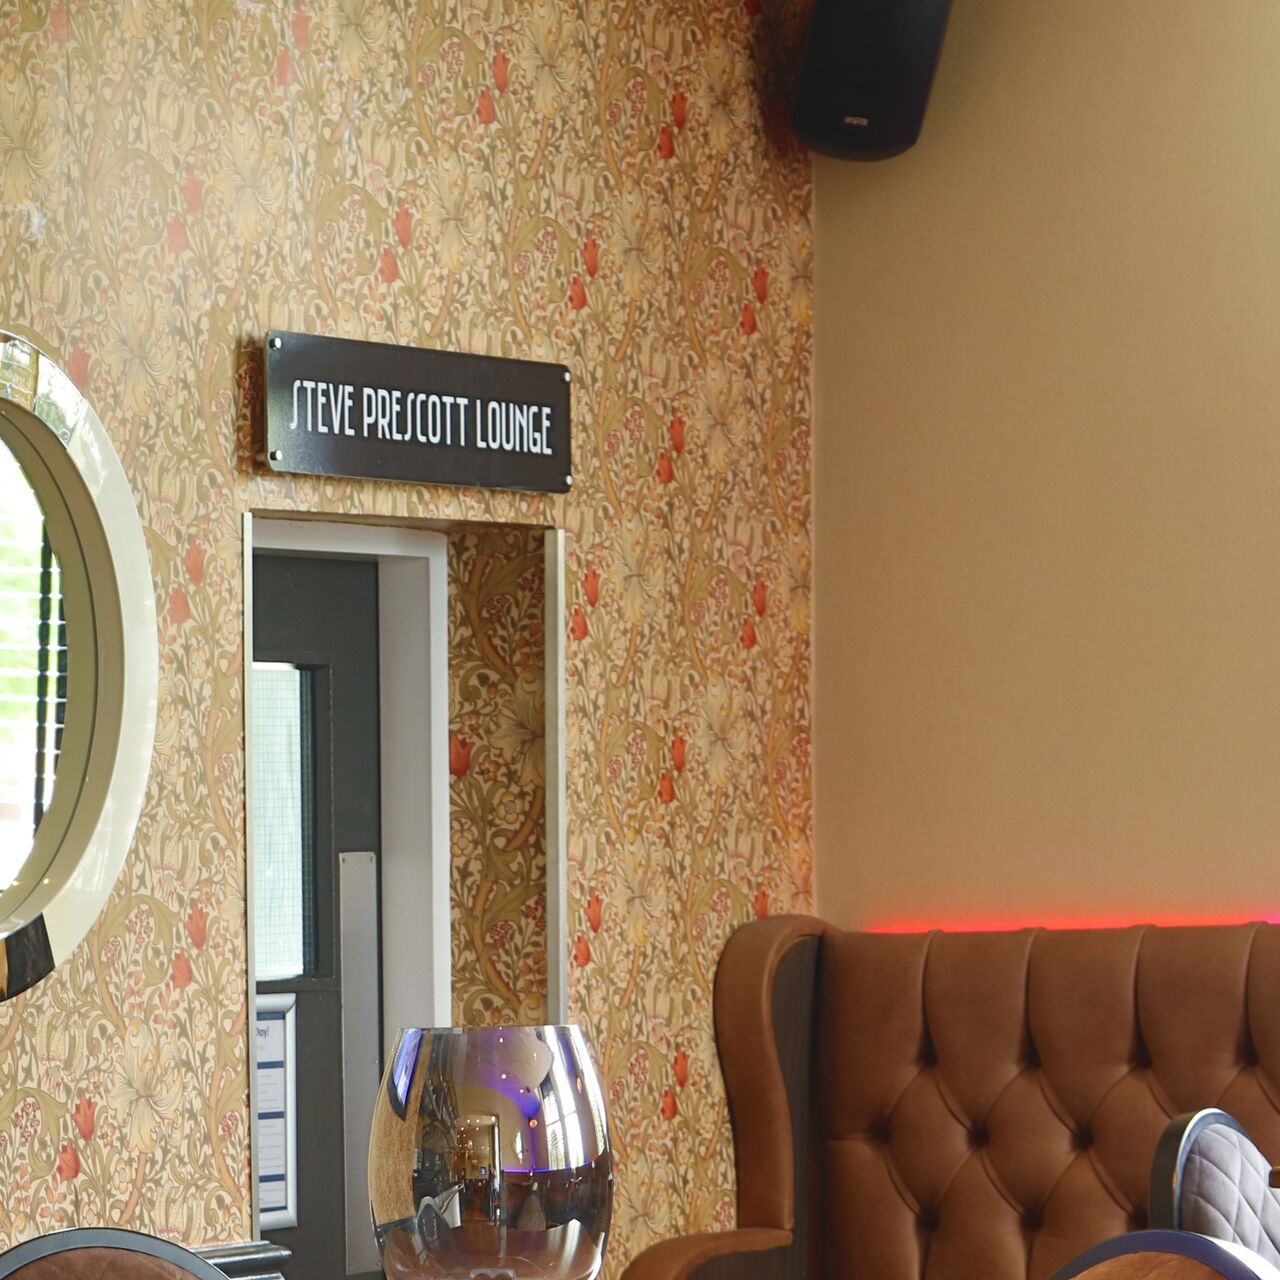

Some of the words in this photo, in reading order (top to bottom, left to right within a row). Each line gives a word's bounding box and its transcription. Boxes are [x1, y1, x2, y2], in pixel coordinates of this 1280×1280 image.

[290, 380, 355, 436] STEVE
[363, 386, 469, 447] PRESCOTT
[475, 398, 553, 456] LOUNGE
